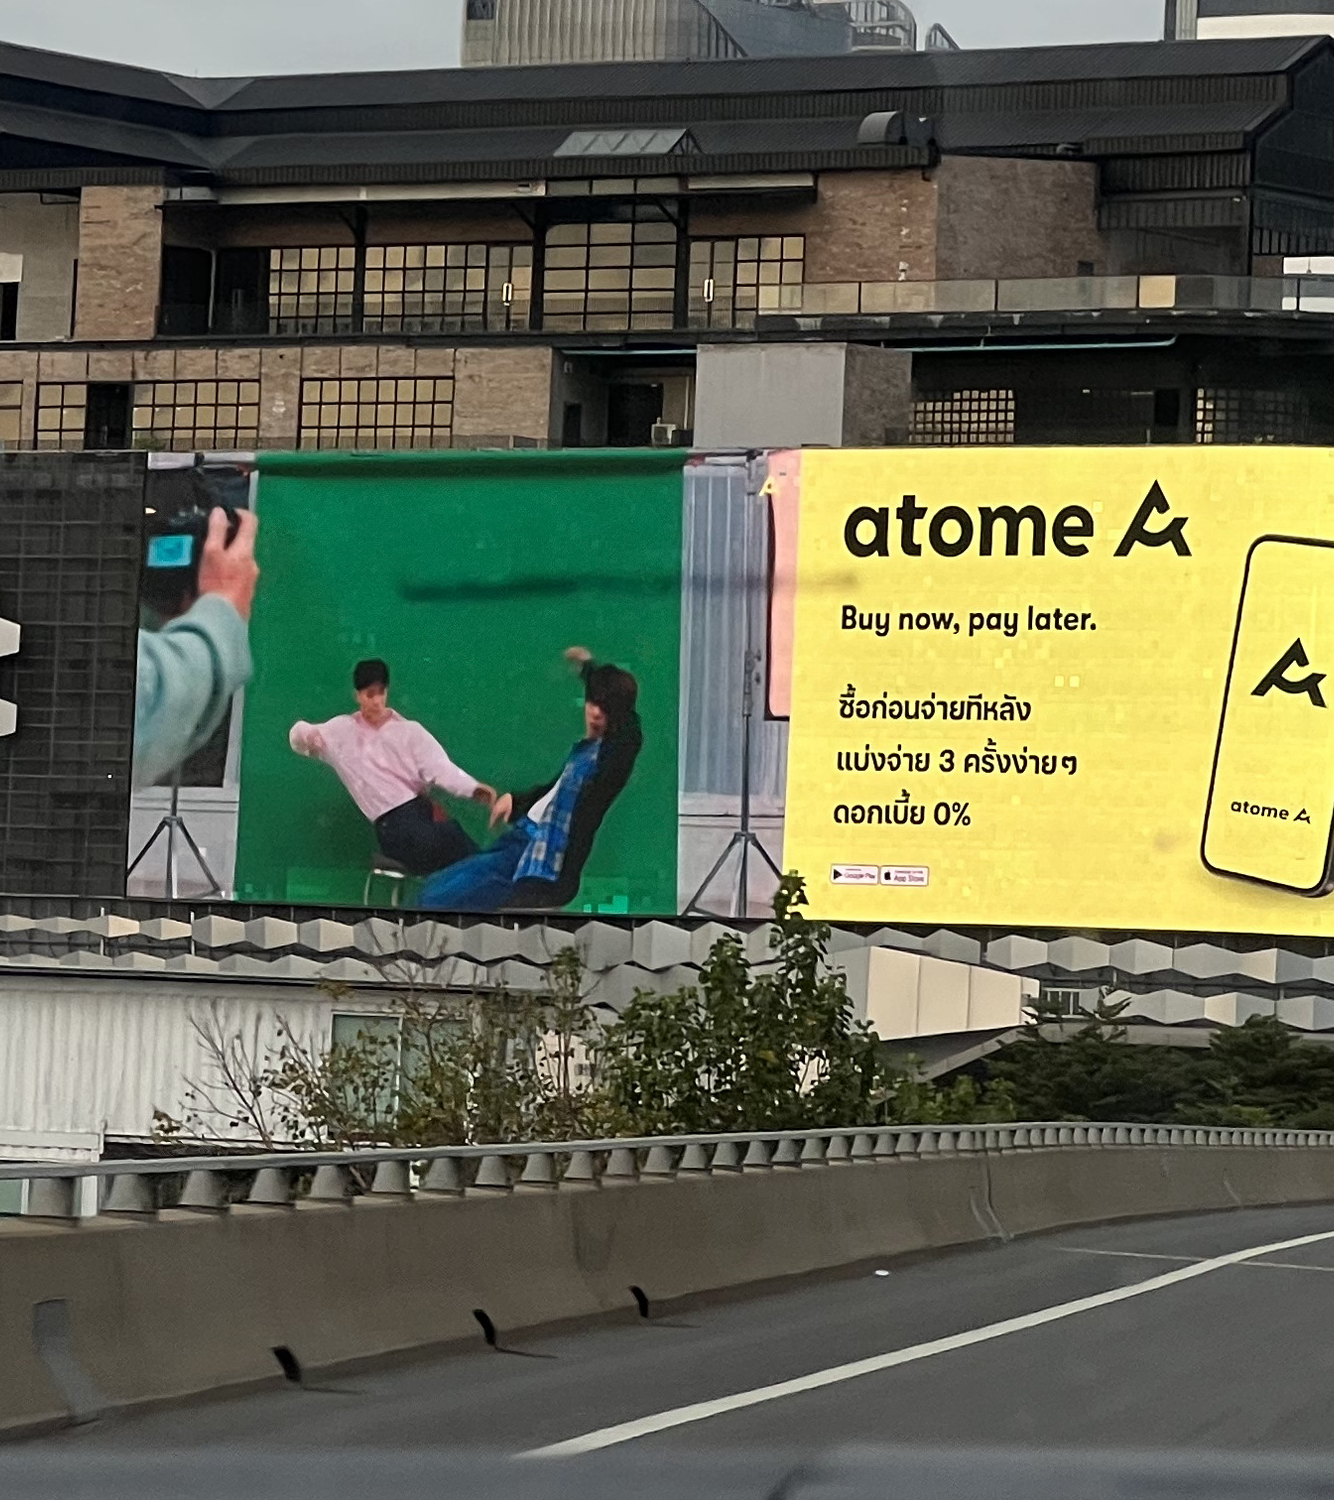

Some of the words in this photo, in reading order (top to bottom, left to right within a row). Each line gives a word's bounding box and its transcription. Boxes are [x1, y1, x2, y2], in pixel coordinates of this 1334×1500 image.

[843, 494, 1095, 558] atome
[841, 604, 891, 637] Buy
[898, 611, 960, 635] now,
[969, 611, 1018, 638] pay
[1027, 604, 1098, 632] later.
[839, 683, 1032, 722] ซื้อก่อนจ่ายทีหลัง
[836, 743, 931, 773] แบ่งจ่าย
[938, 749, 956, 773] 3
[833, 788, 926, 825] ดอกเบี้ย
[933, 801, 972, 827] 0%
[1230, 801, 1290, 820] atome
